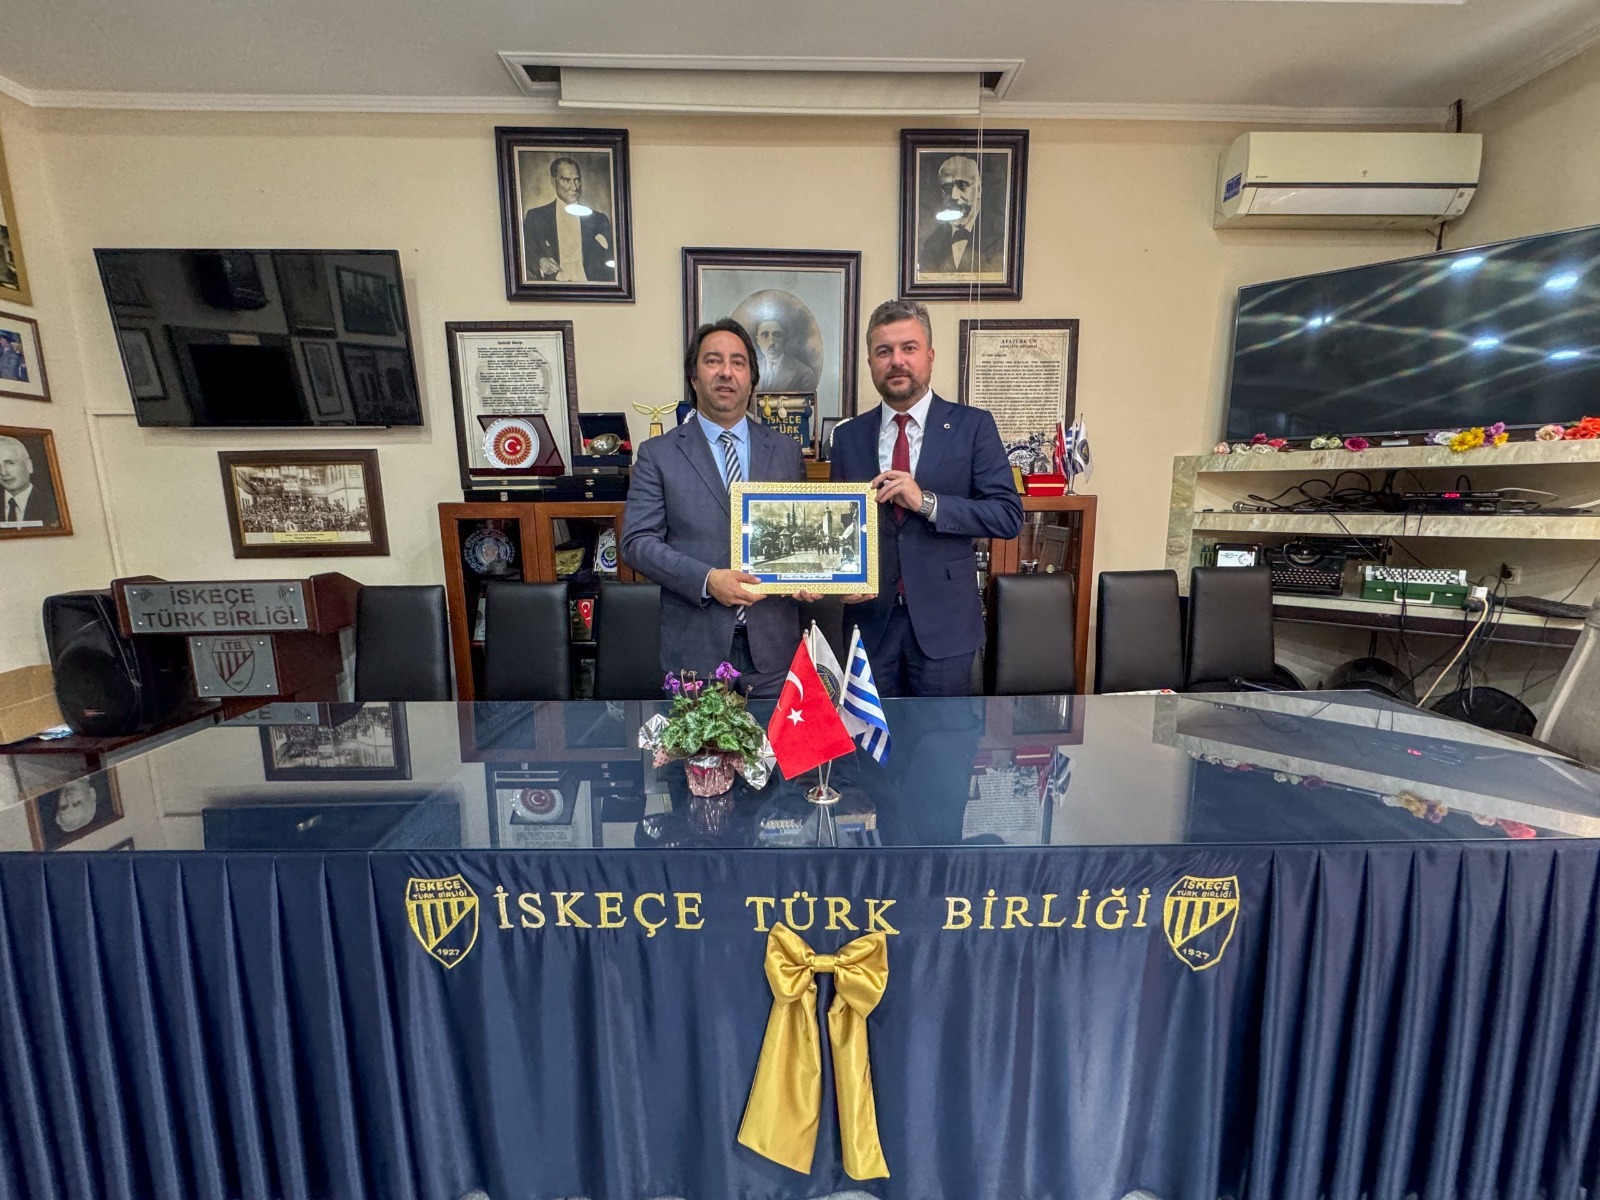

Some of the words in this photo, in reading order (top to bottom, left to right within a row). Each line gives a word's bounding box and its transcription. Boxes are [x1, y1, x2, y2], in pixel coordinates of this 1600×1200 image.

[169, 586, 256, 608] İSKEÇE
[142, 608, 206, 628] TÜRK
[213, 606, 297, 627] BİRLİĞİ
[415, 880, 461, 892] İSKEÇE
[1183, 879, 1232, 891] İSKEÇE
[494, 885, 706, 938] İSKEÇE
[745, 891, 900, 935] TÜRK
[942, 886, 1151, 930] BİRLİĞİ
[436, 948, 460, 956] 1927
[1182, 948, 1210, 960] 1927
